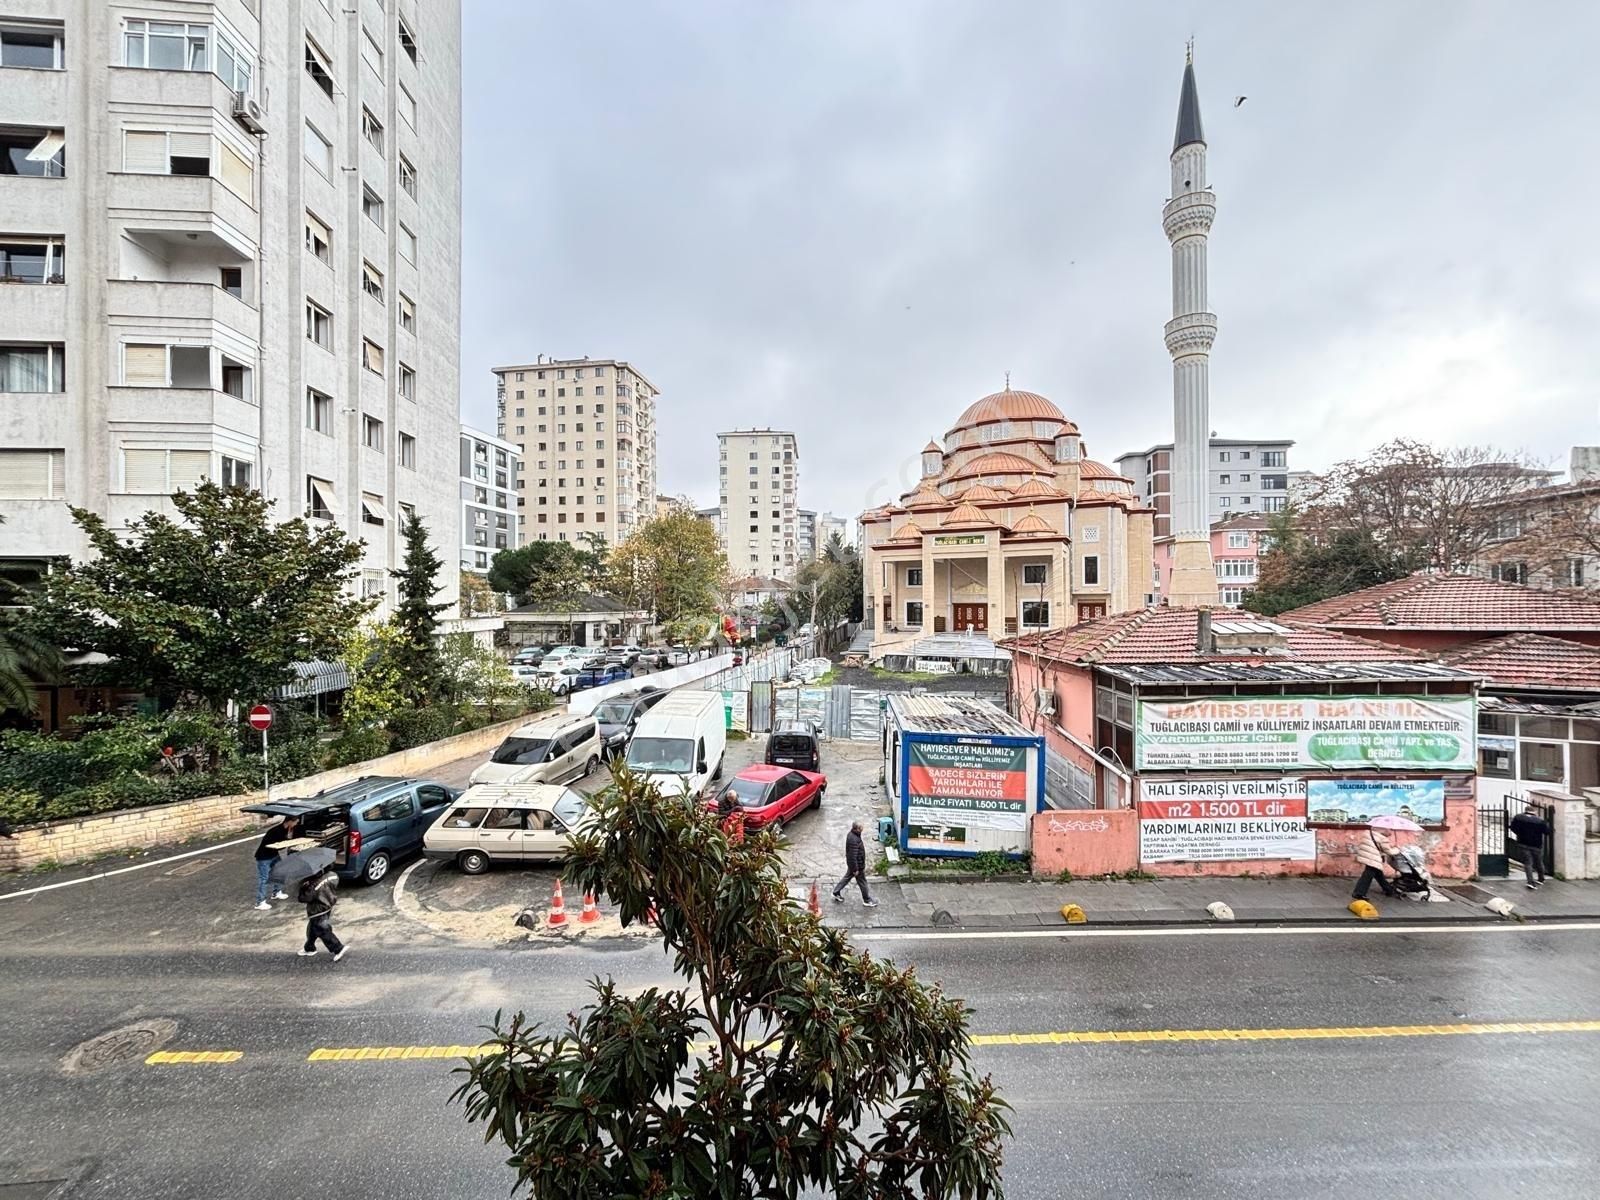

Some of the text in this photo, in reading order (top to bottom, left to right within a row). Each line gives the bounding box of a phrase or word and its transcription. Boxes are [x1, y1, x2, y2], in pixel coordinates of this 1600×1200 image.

[1167, 703, 1303, 719] HAYIRSEVER
[1150, 718, 1463, 733] TUĞLACIBAŞI CAMİİ ve KÜLLİYEMİZ İNŞAATLARI DEVAM ETMEKTEDİR.
[1153, 734, 1248, 743] YARDIMLARINIZ
[920, 743, 1015, 757] HAYIRSEVER HALKIMIZ'a
[927, 753, 960, 762] TUĞLACIBAŞI
[982, 756, 1011, 764] KÜLLİYEMİZ
[953, 761, 983, 769] İNŞAATLARI
[928, 769, 1007, 780] SADECE SİZLERİN
[932, 779, 1002, 789] YARDIMLARI İLE
[1148, 780, 1306, 798] HALI SİPARİŞİ VERİLMİŞTİR
[1336, 782, 1367, 790] TUĞLACIBAŞI
[1390, 782, 1415, 790] KÜLLİYESİ
[931, 786, 1004, 797] TAMAMLANIYOR
[912, 797, 1022, 810] HALI m2 FİYATI 1.500 TL dir
[1168, 802, 1287, 817] m2 1.500 TL dir
[1143, 819, 1312, 835] YARDIMLARINIZI BEKLİYORU
